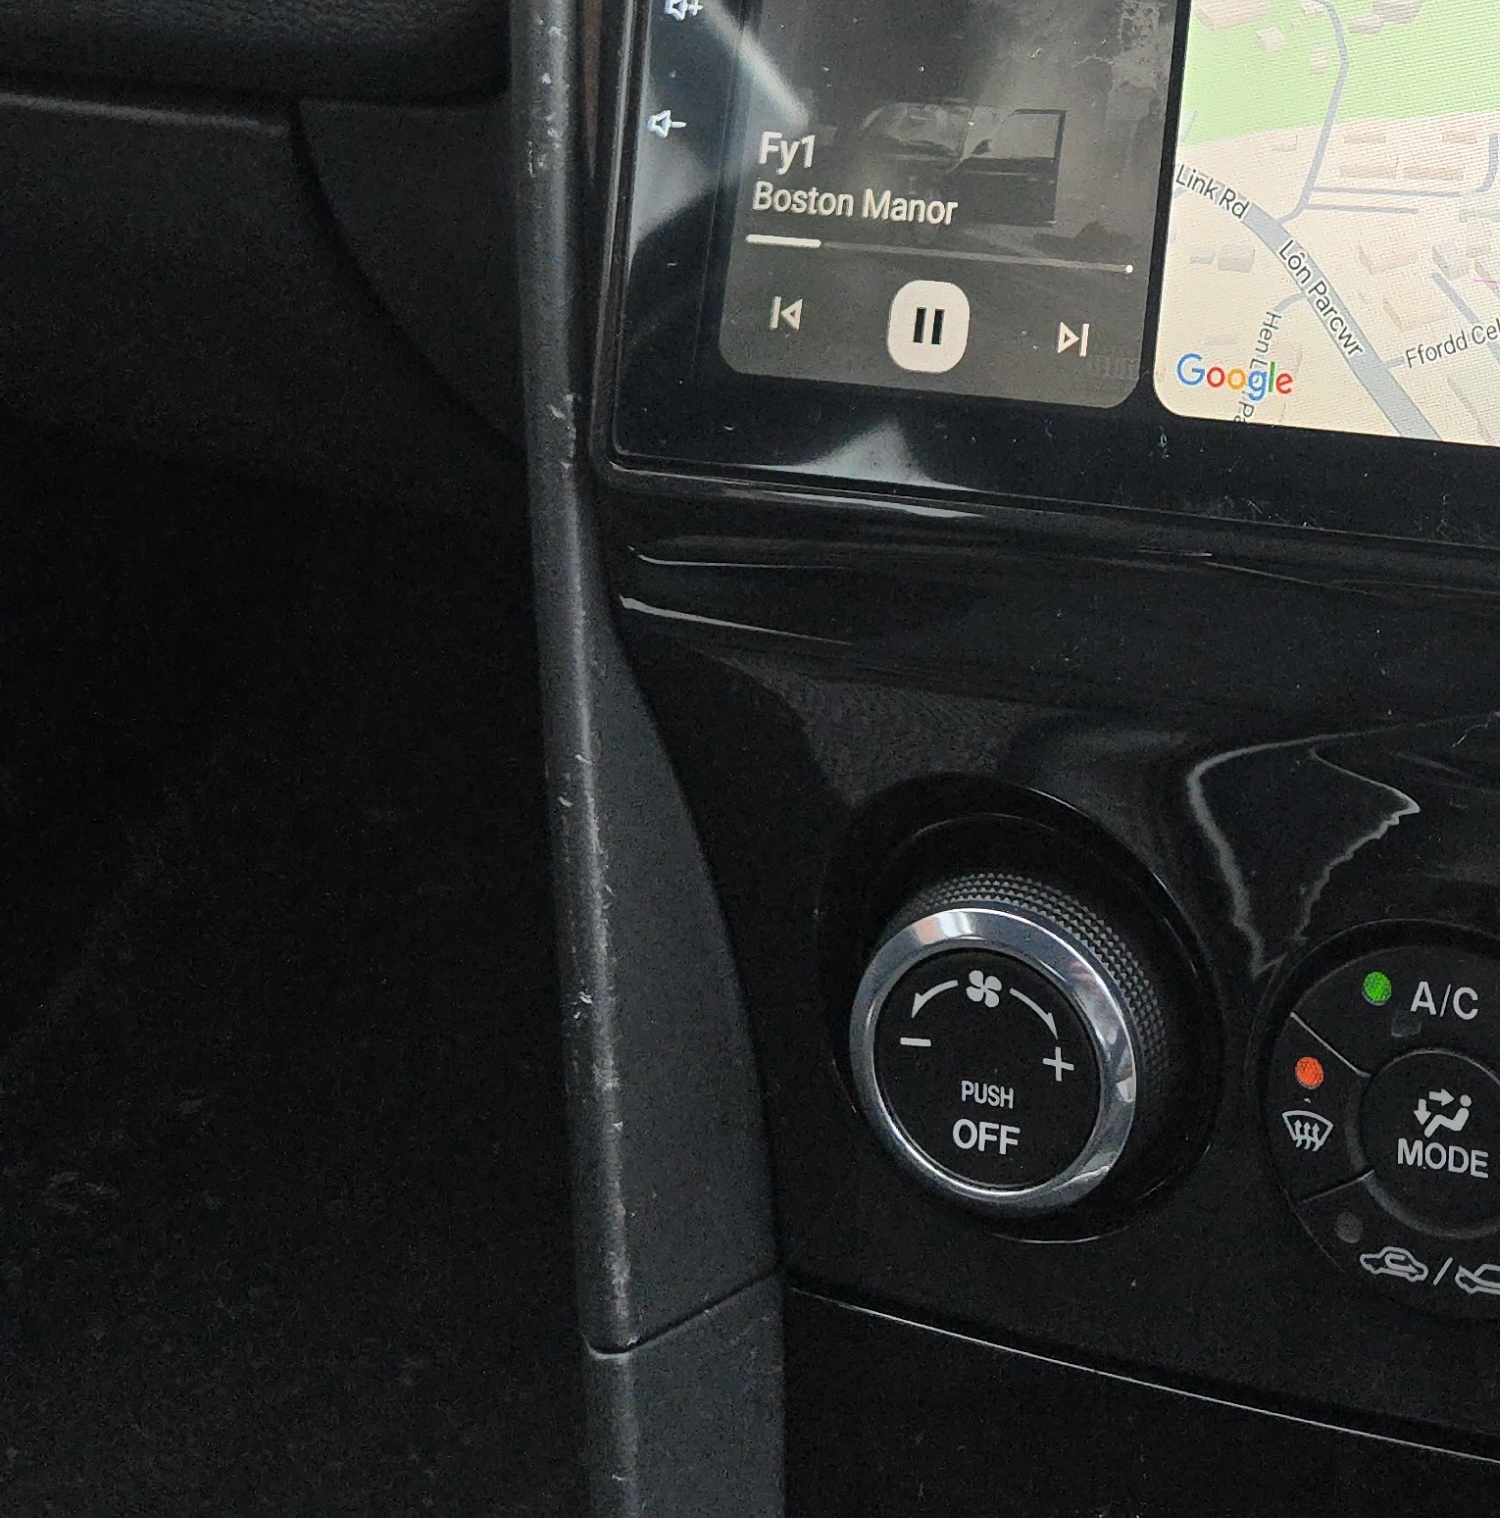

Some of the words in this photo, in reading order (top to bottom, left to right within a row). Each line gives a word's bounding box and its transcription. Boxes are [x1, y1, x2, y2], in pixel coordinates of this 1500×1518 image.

[758, 131, 815, 176] Fy1
[752, 180, 854, 217] Boston
[861, 187, 959, 226] Manor
[1175, 163, 1219, 200] Link
[1218, 187, 1251, 220] Rd
[1254, 311, 1283, 354] Hen
[1307, 280, 1364, 356] Parcwr
[1404, 329, 1469, 370] Ffordd
[1176, 353, 1294, 402] Google
[1410, 981, 1480, 1020] A/C
[961, 1080, 1014, 1109] PUSH
[952, 1118, 1021, 1155] OFF
[1397, 1137, 1490, 1179] MODE
